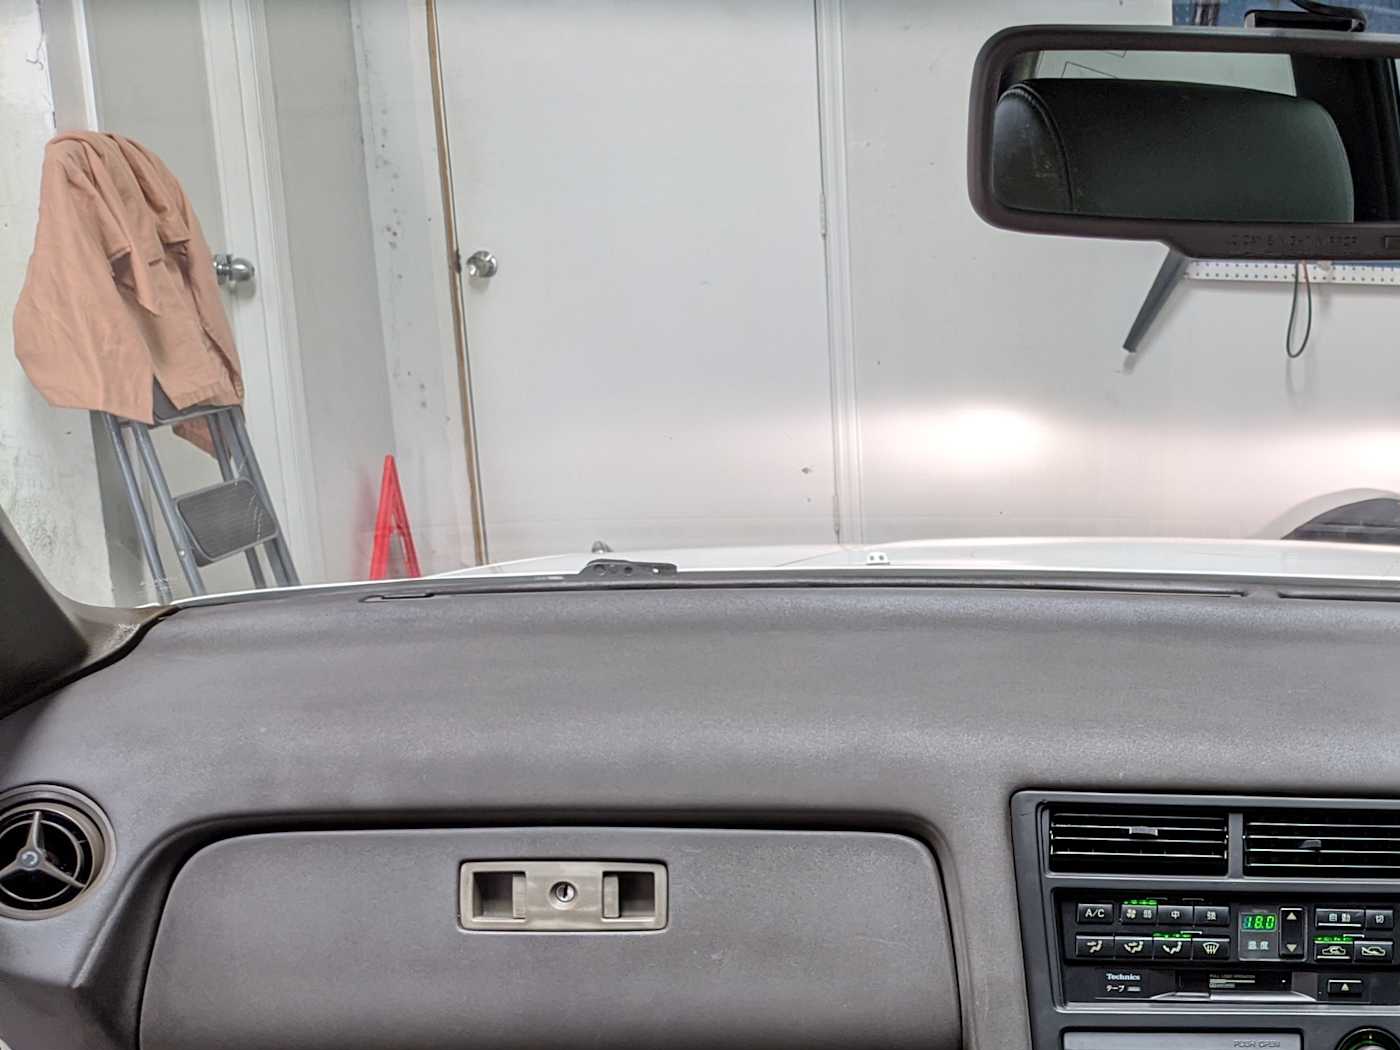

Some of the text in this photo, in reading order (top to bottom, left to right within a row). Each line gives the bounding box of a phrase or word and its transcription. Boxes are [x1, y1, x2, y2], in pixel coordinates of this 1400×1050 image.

[1085, 908, 1105, 918] A/C
[1171, 910, 1180, 920] 中
[1105, 973, 1141, 981] Technics
